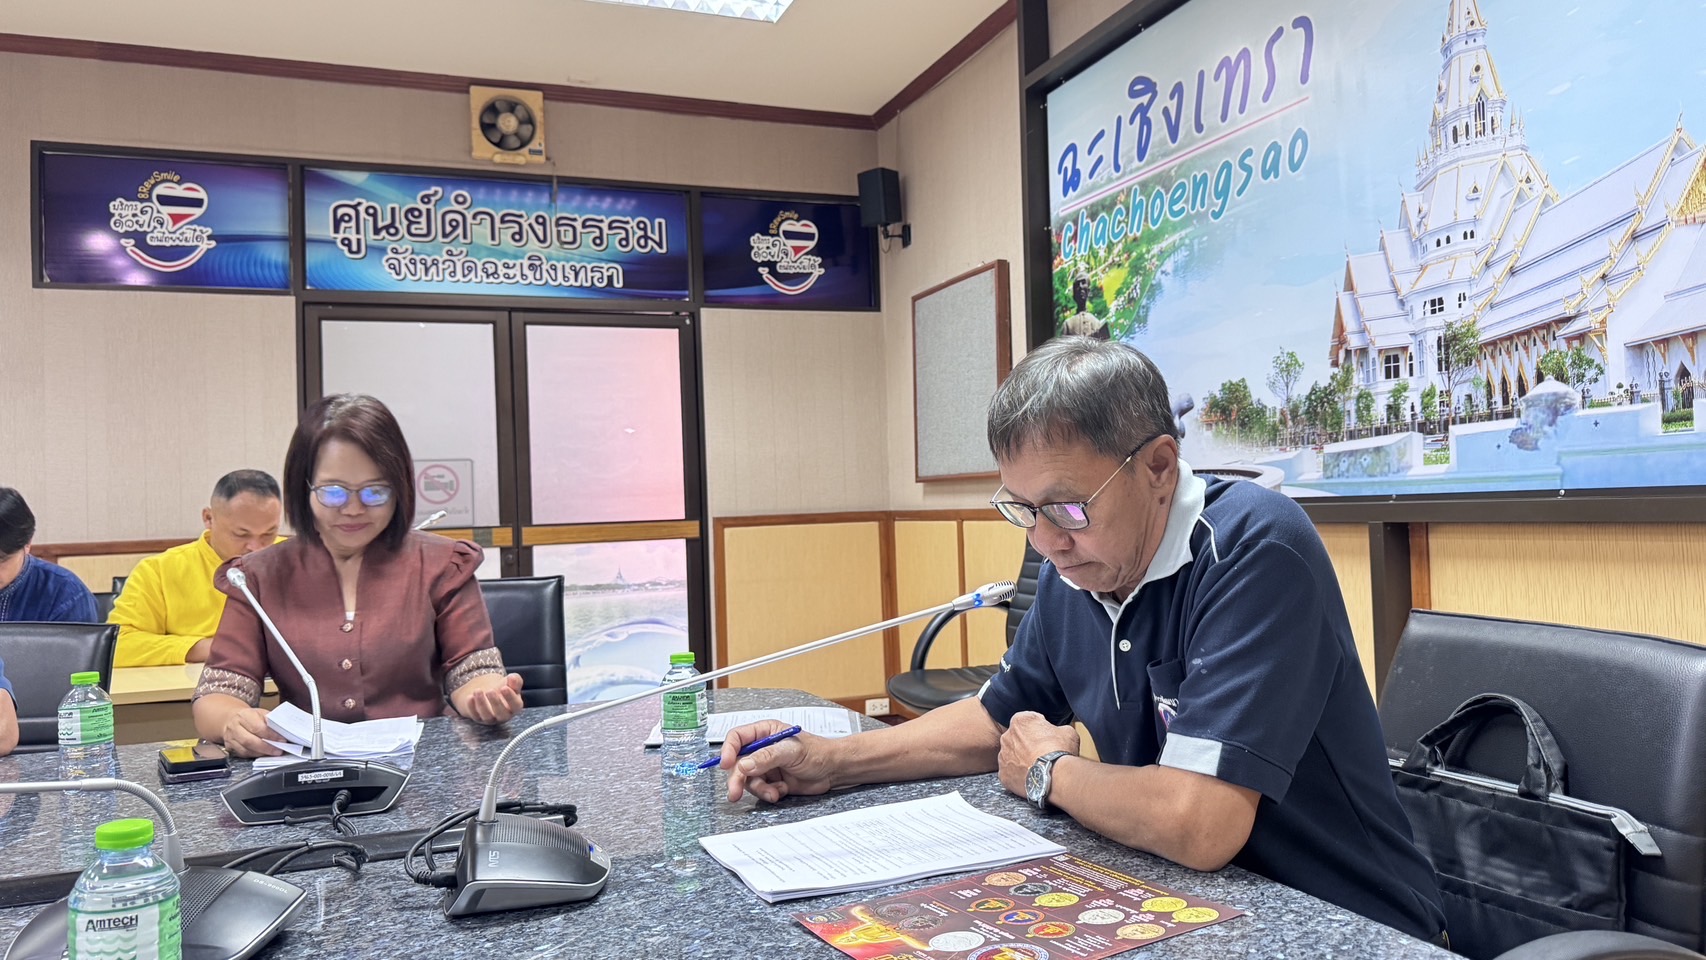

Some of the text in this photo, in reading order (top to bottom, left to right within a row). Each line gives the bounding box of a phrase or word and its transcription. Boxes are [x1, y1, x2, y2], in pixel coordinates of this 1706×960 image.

[1058, 15, 1314, 198] ฉะเชิงเทรา
[331, 187, 667, 258] ศูนย์ดำรงธรรม
[385, 246, 624, 288] จังหวัดฉะเชิงเทรา
